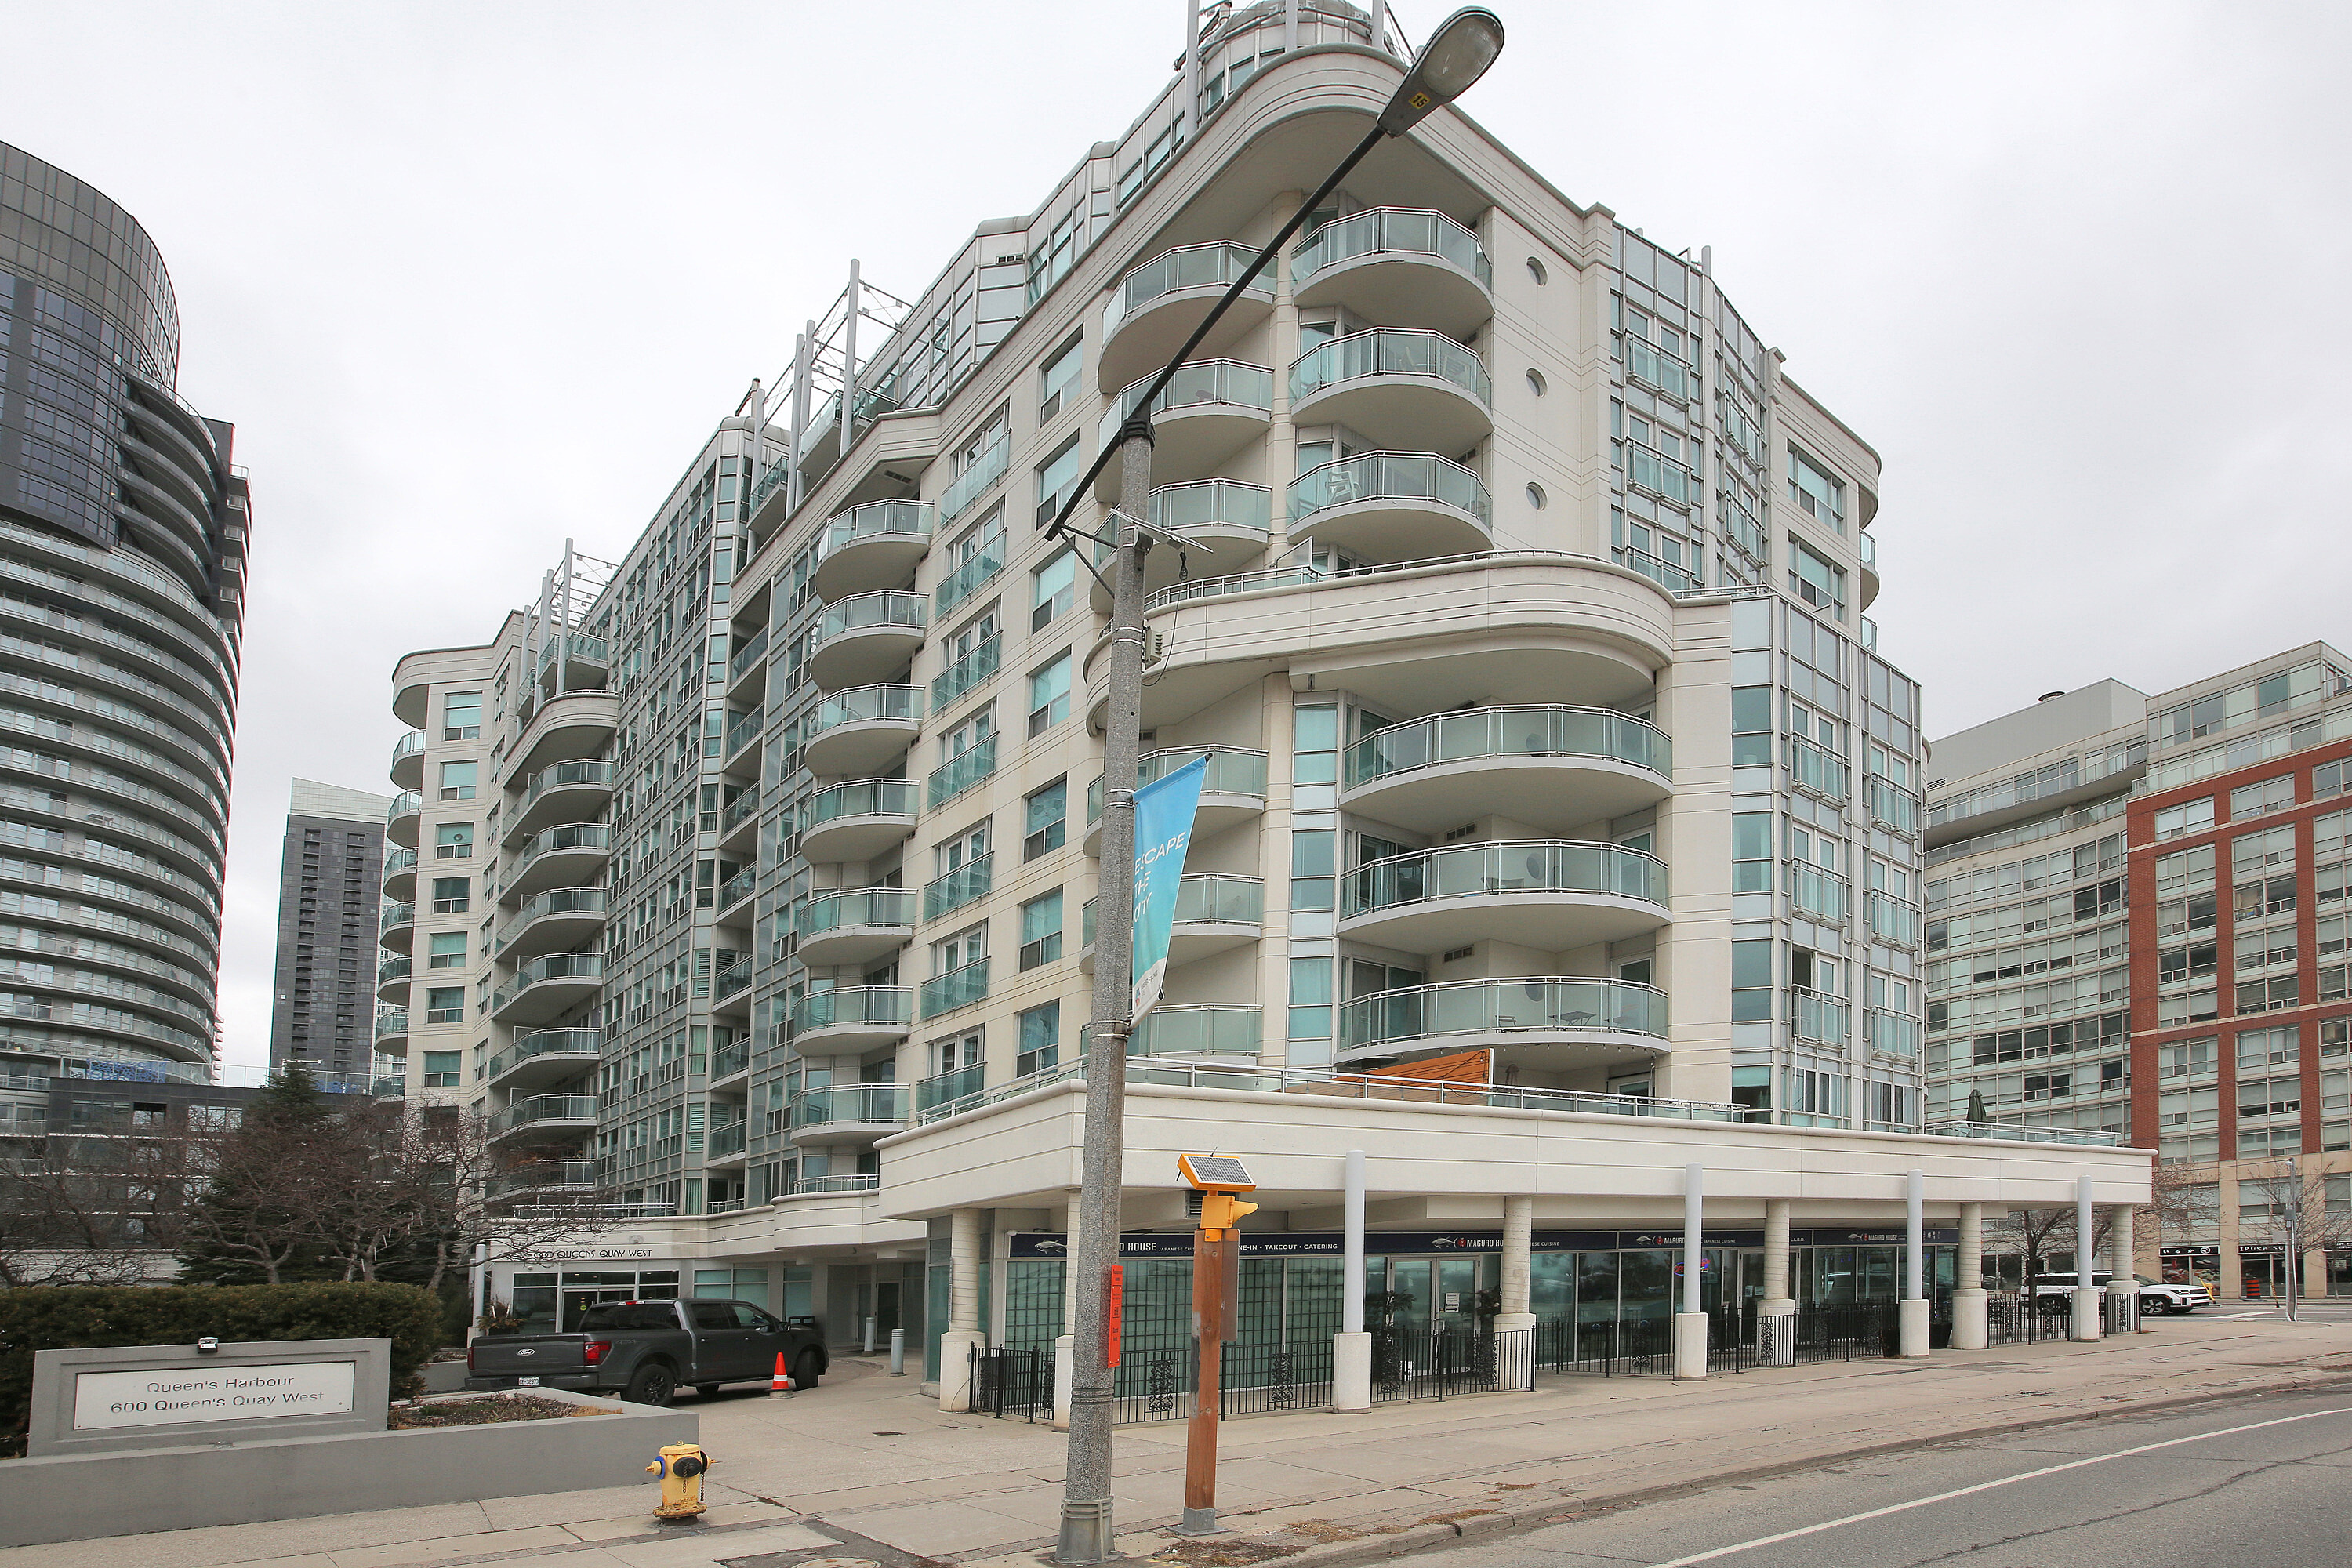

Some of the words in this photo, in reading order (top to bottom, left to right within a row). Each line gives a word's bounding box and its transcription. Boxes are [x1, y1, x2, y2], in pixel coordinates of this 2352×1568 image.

[1413, 95, 1428, 107] 15
[1134, 870, 1151, 898] THE
[1127, 1242, 1156, 1251] HOUSE
[1466, 1239, 1494, 1247] MAGURO
[557, 1250, 594, 1258] QUEENS
[599, 1250, 626, 1258] QUAY
[147, 1381, 218, 1393] Queen's
[225, 1377, 295, 1389] Harbour
[111, 1401, 147, 1414] 600
[154, 1398, 226, 1411] Queen's
[233, 1396, 276, 1406] Quay
[283, 1392, 325, 1403] West
